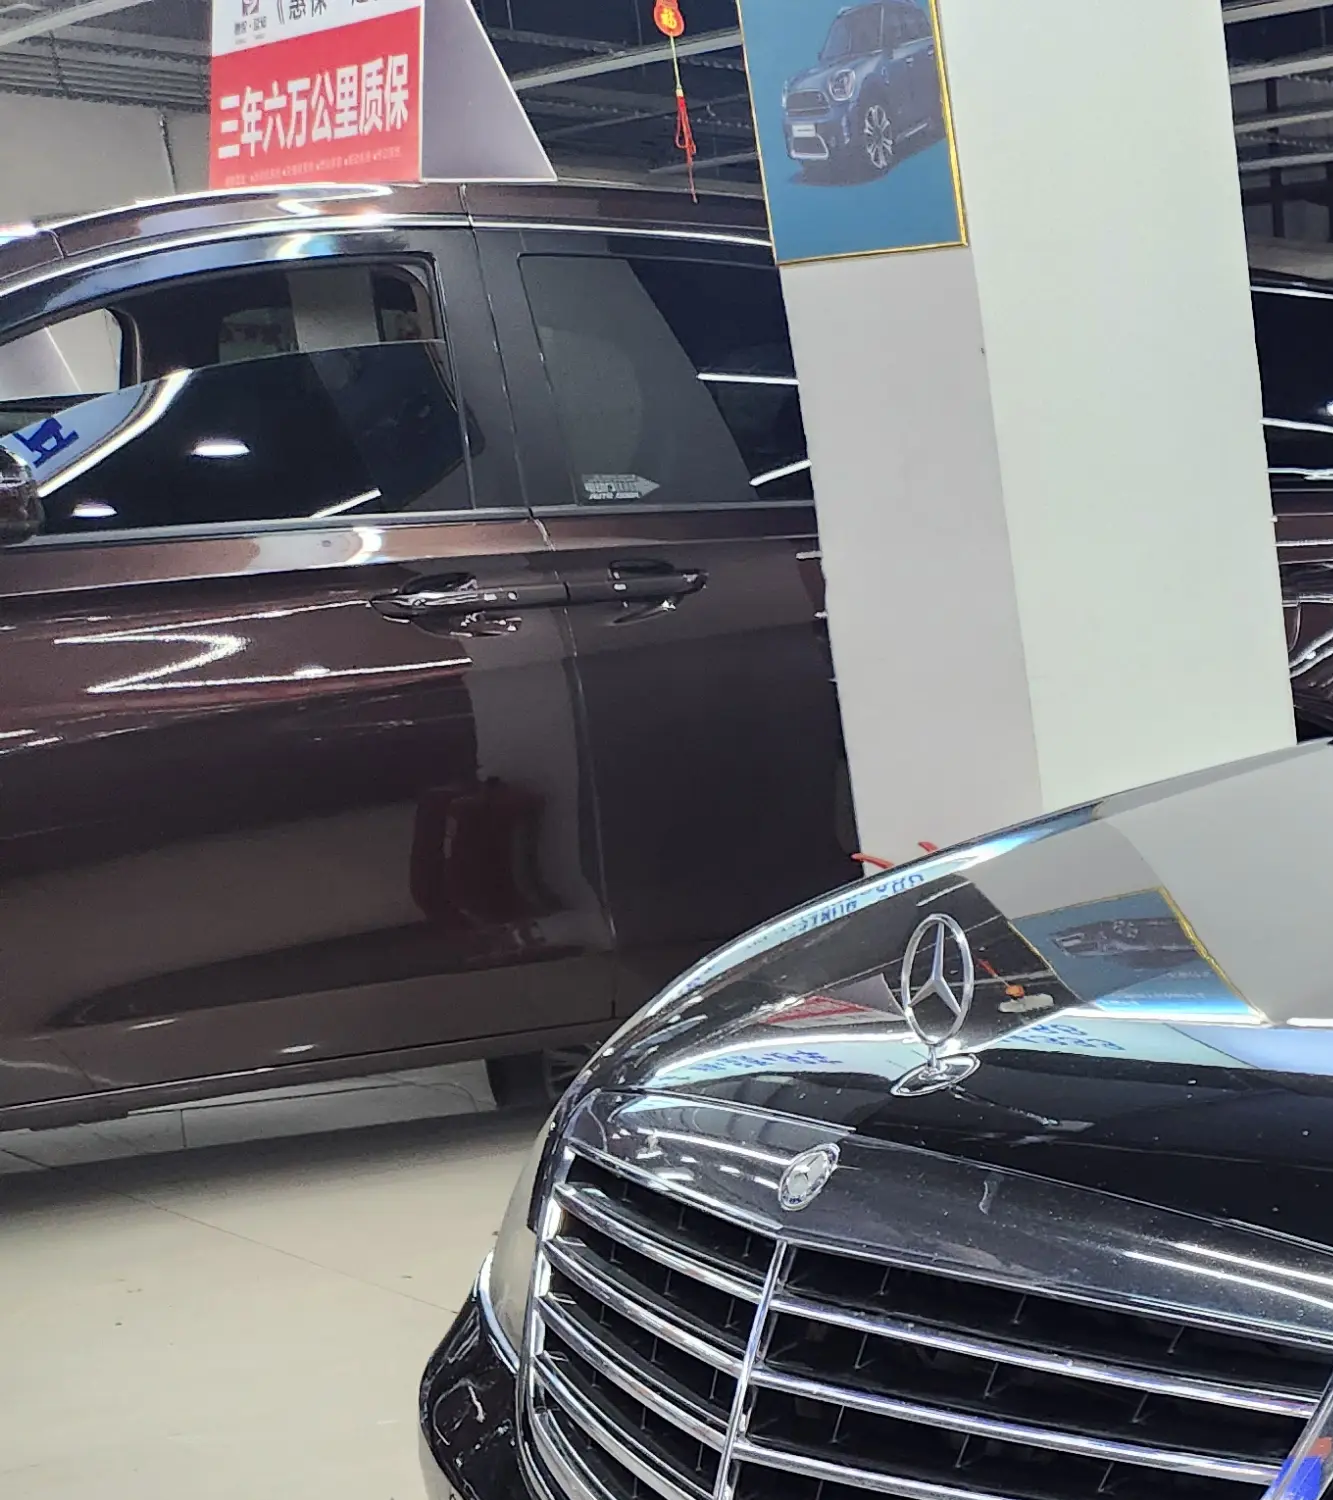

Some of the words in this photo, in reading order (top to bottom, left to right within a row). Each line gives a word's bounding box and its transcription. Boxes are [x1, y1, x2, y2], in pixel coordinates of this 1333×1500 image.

[217, 53, 409, 160] 三年六万公里质保
